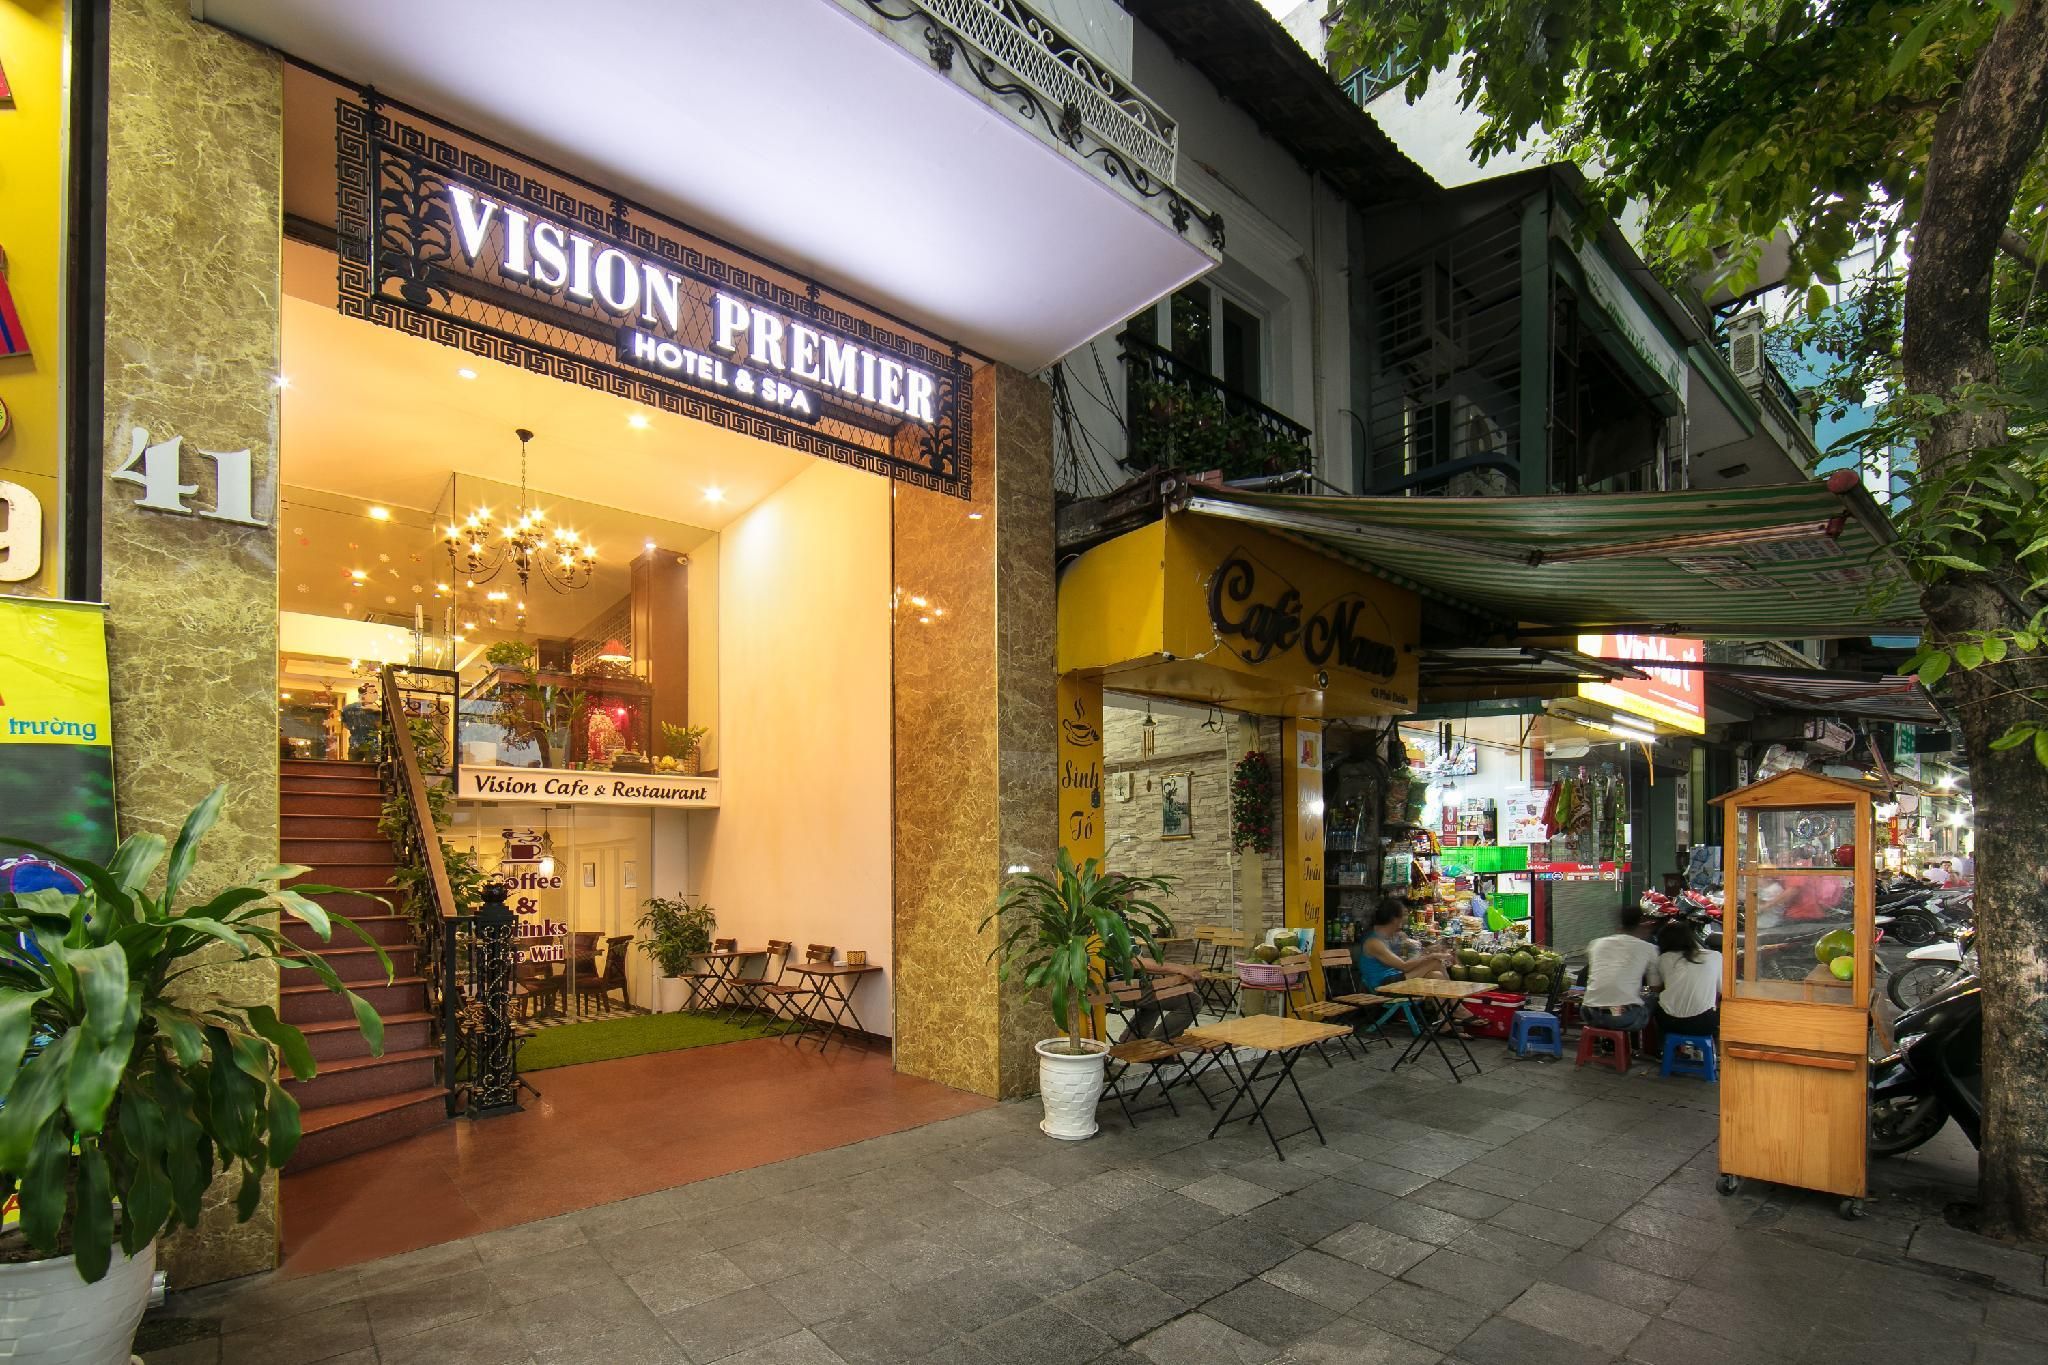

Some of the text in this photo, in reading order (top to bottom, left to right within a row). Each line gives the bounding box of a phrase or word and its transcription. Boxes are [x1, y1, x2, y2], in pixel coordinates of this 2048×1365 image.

[448, 185, 934, 423] VISION PREMIER
[634, 333, 811, 414] HOTEL & SPA
[111, 427, 269, 528] 41
[9, 717, 97, 741] trường
[474, 774, 707, 800] Vision Cafe & Restaurant
[1062, 759, 1101, 790] Sinh
[1070, 810, 1094, 841] Tố
[490, 872, 562, 889] offee
[515, 897, 538, 914] &
[529, 945, 565, 962] Wifi
